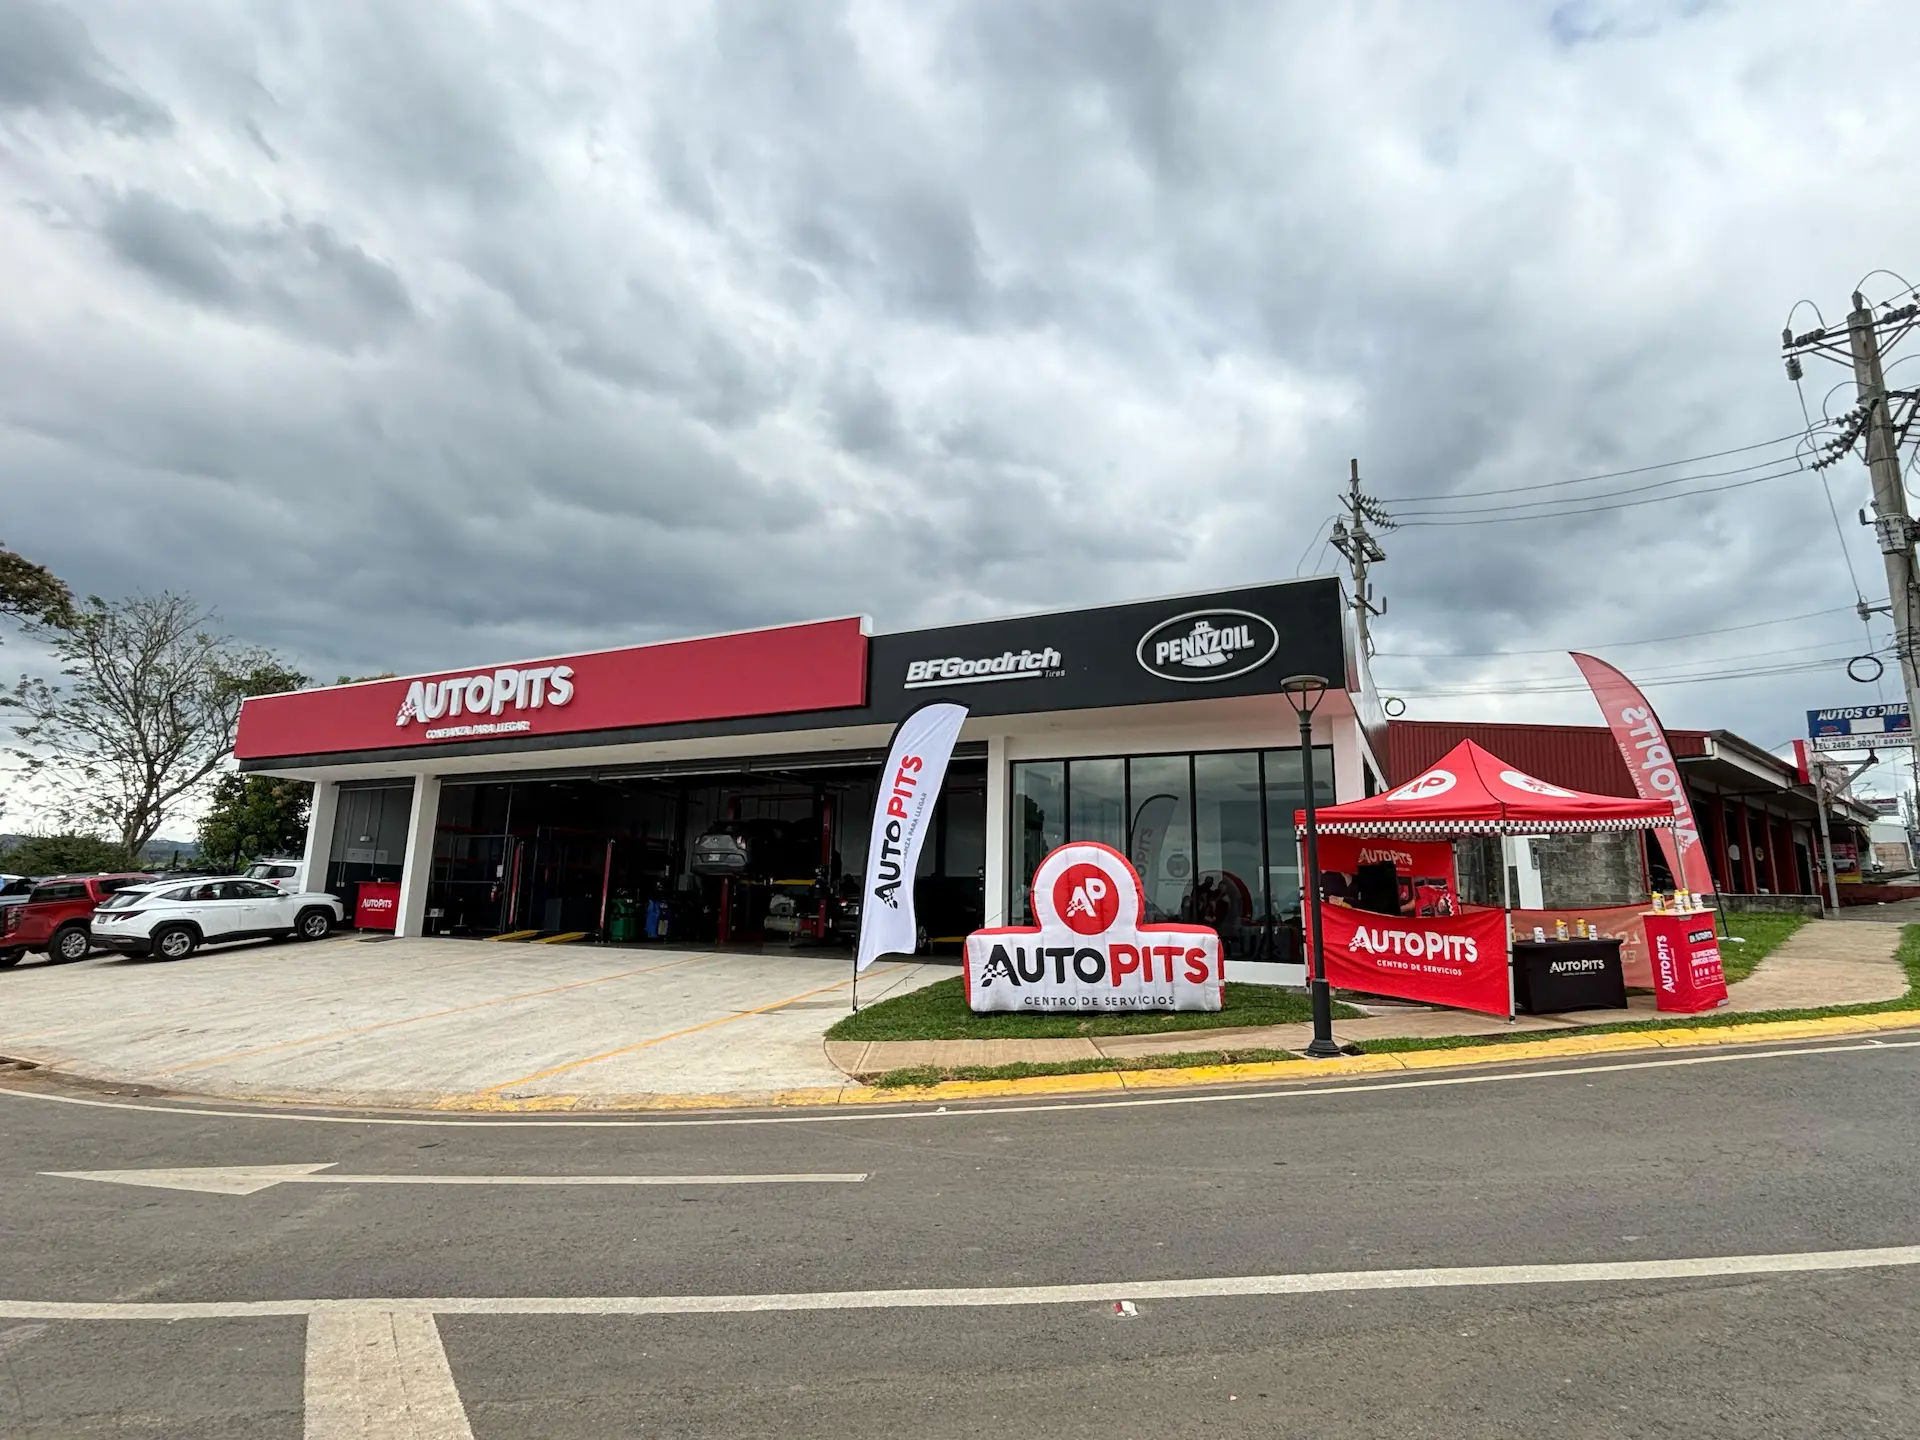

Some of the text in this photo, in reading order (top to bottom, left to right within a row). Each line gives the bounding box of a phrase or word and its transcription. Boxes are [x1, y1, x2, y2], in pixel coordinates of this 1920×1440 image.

[1156, 625, 1255, 665] PENNZOIL
[906, 647, 1061, 682] BFGoodrich
[1045, 669, 1065, 678] Tires
[396, 665, 575, 726] AUTOPITS
[1817, 704, 1909, 721] AUTOS GOME
[473, 724, 495, 734] PARA
[1832, 741, 1851, 749] 2495
[874, 755, 923, 909] AUTOPITS
[1358, 848, 1413, 865] AUTOPITS
[360, 898, 393, 908] AUTOPITS
[1066, 878, 1106, 917] AP
[1349, 925, 1478, 962] AUTOPITS
[981, 944, 1209, 987] AUTOPITS
[1376, 959, 1409, 970] CENTRO
[1423, 965, 1462, 976] SERVICIOS
[1549, 959, 1605, 973] AUTOPITS
[1656, 935, 1676, 993] AUTOPITS
[1024, 995, 1175, 1006] CENTRO DE SERVICIOS
